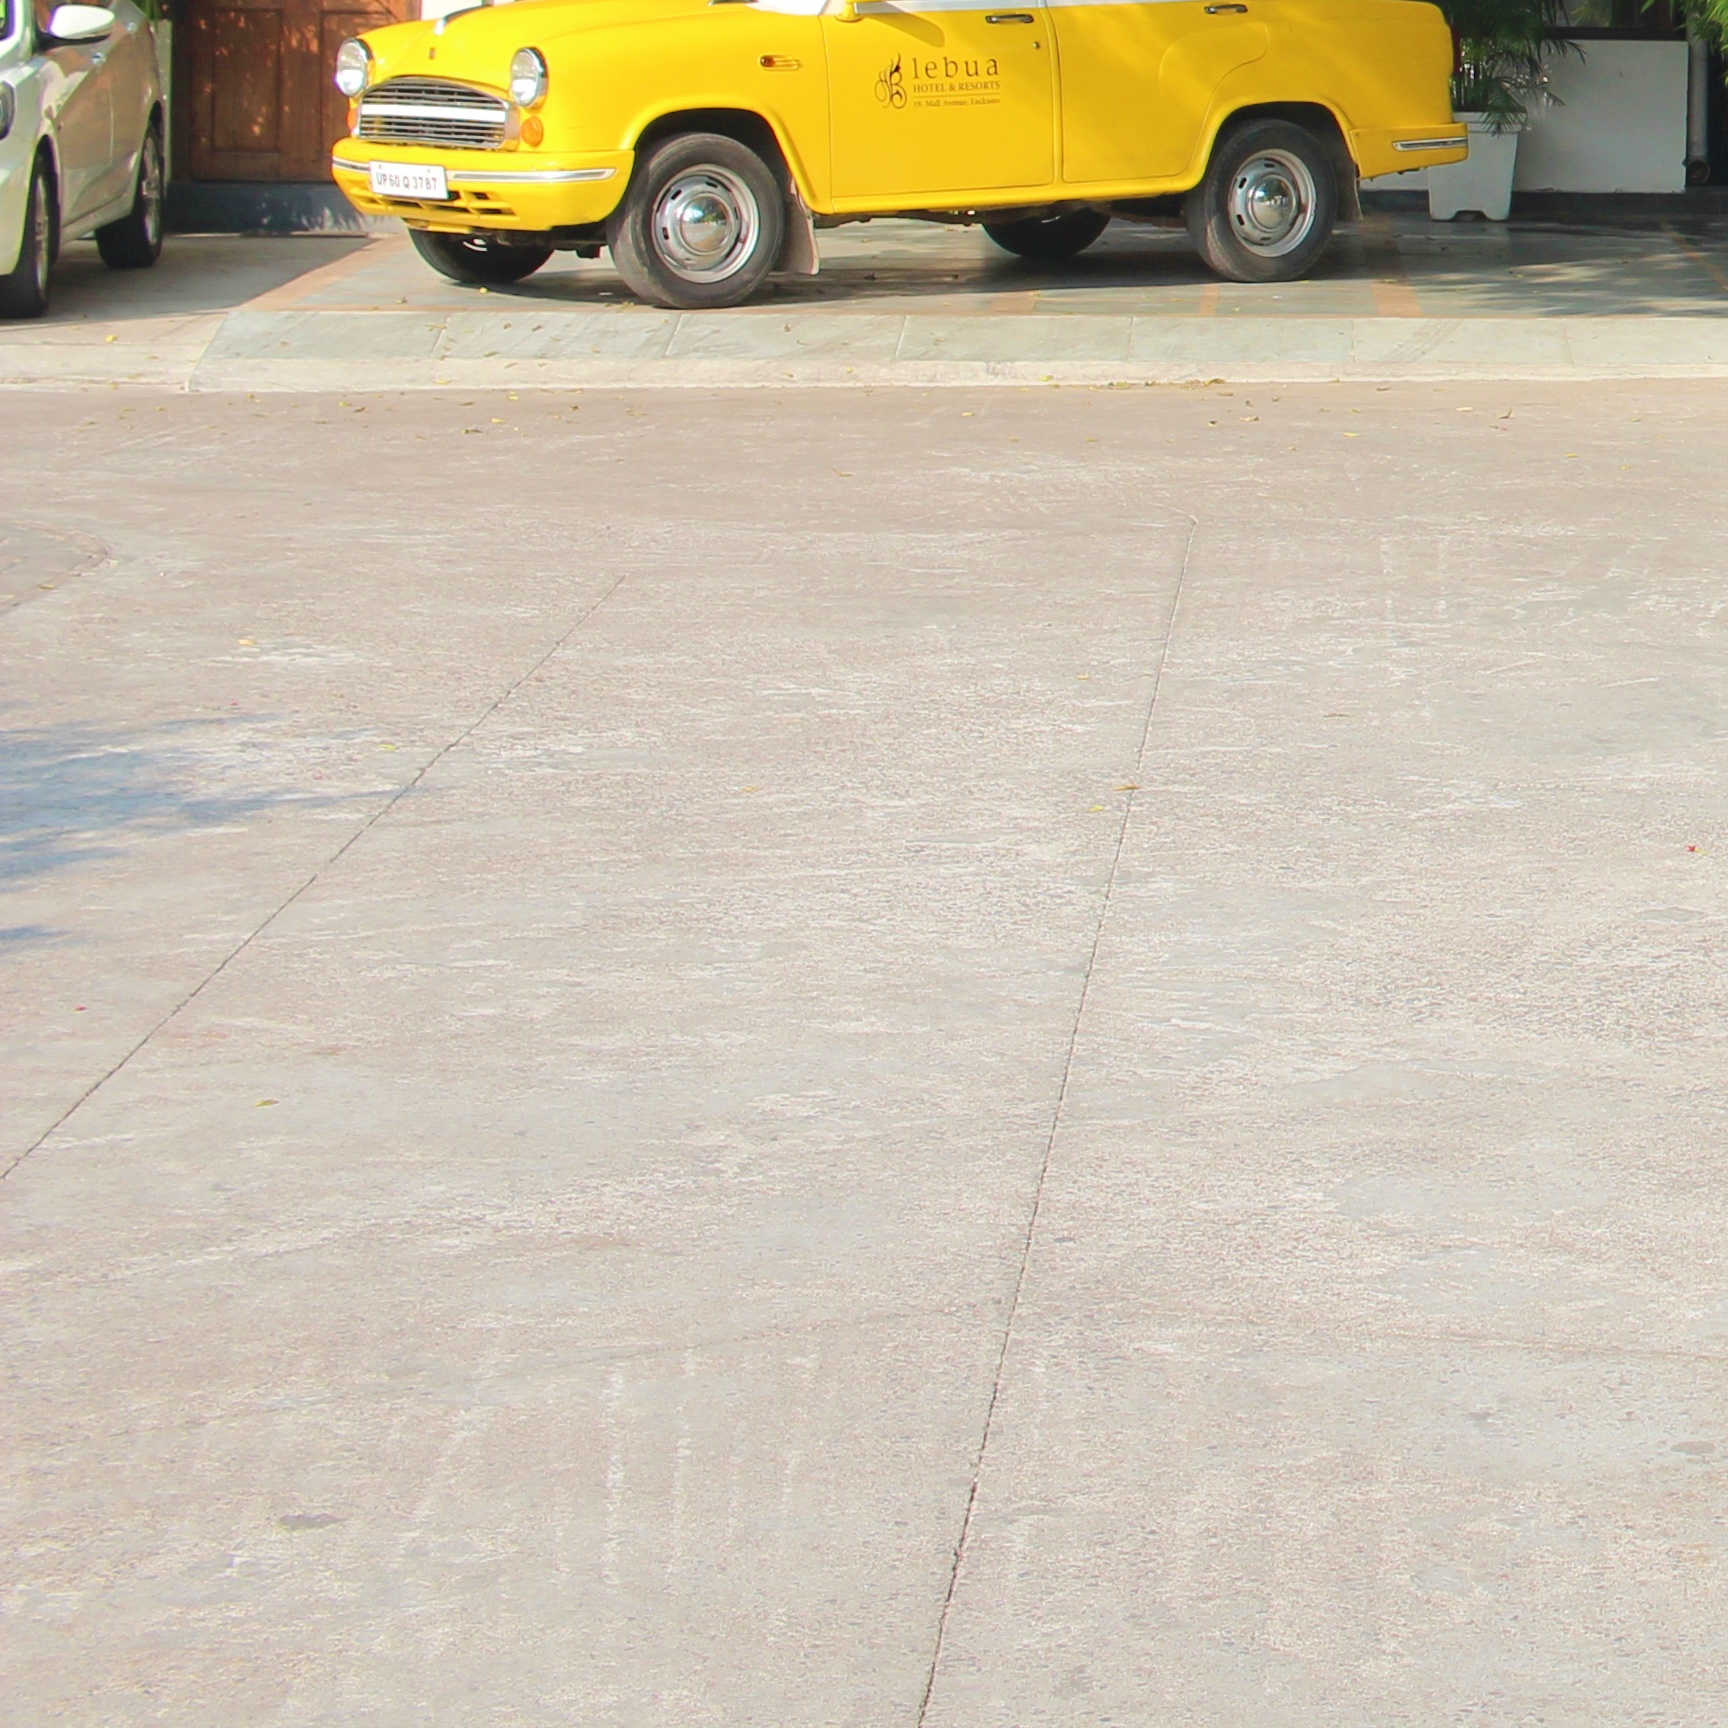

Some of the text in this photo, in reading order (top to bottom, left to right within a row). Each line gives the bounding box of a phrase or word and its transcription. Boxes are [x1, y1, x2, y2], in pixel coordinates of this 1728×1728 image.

[912, 56, 1000, 79] lebua
[913, 81, 1001, 93] HOTEL & RESORTS
